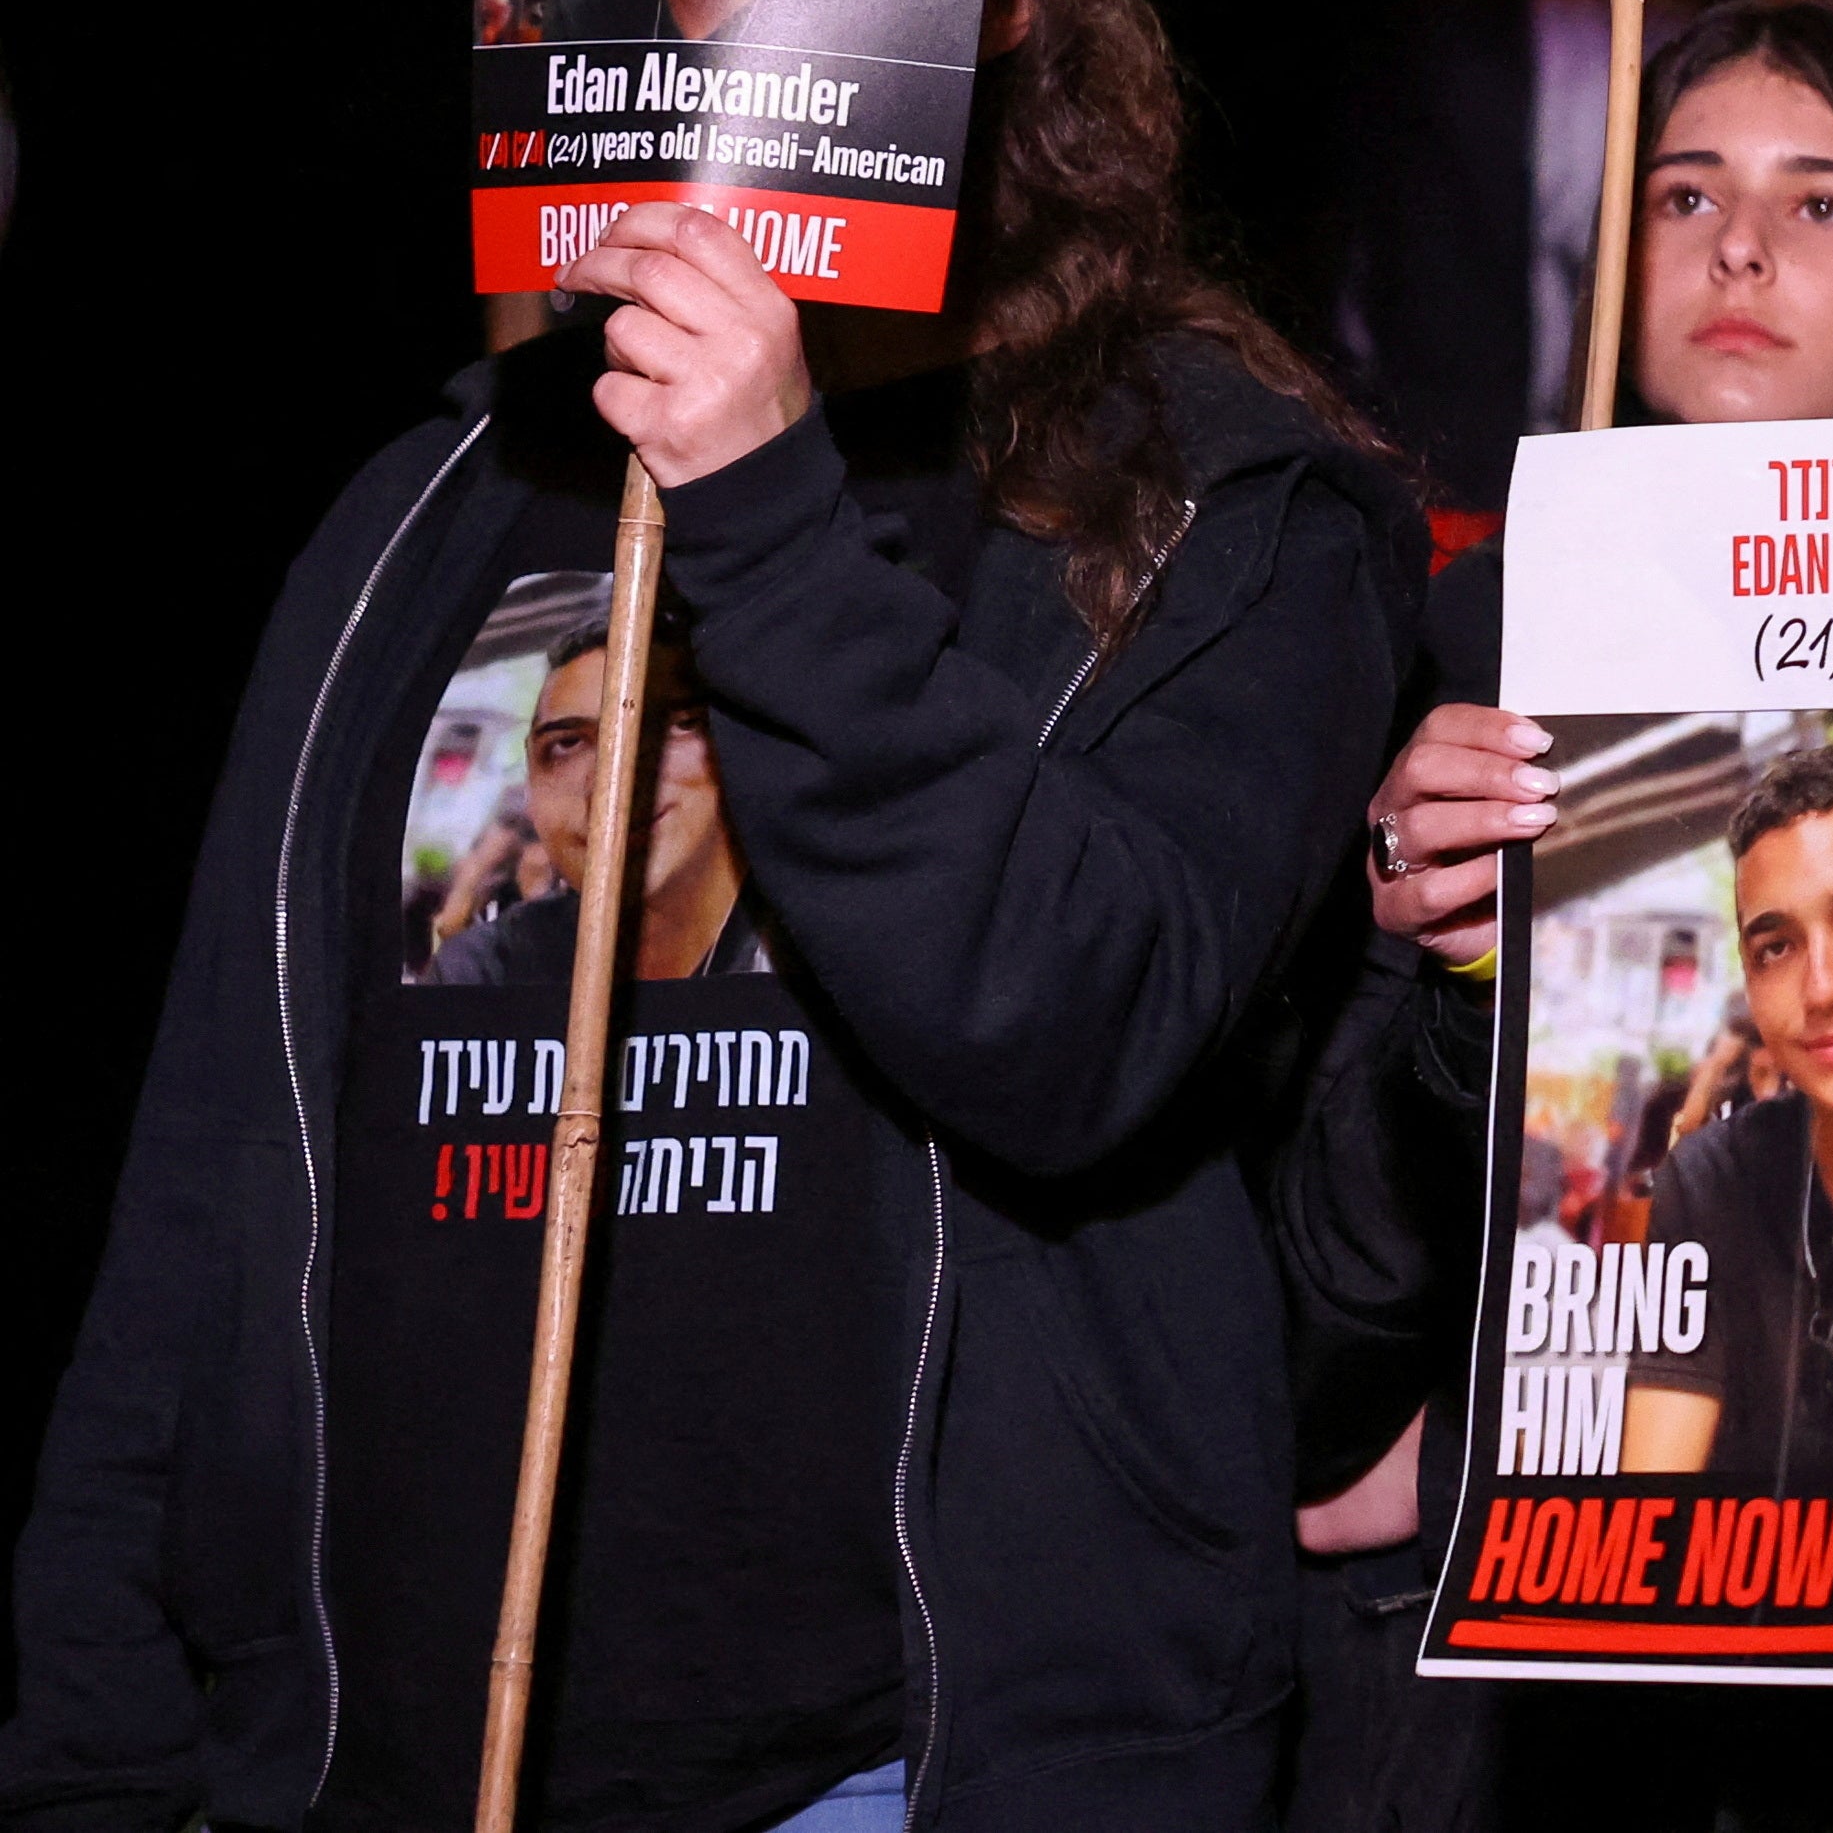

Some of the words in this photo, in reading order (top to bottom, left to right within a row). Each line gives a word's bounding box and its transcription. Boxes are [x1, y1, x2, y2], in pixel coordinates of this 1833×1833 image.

[547, 54, 628, 115] Edan
[634, 52, 860, 127] Alexander
[592, 130, 655, 169] years
[660, 129, 701, 161] old
[706, 131, 946, 187] Israeli-American
[1732, 533, 1829, 597] EDAN
[418, 1039, 517, 1125] עידן
[620, 1030, 810, 1113] מחזירים
[431, 1143, 547, 1222] שיו!
[617, 1136, 778, 1216] הביתה
[1506, 1240, 1710, 1355] BRING
[1497, 1365, 1630, 1476] HIM
[1468, 1497, 1675, 1606] HOME
